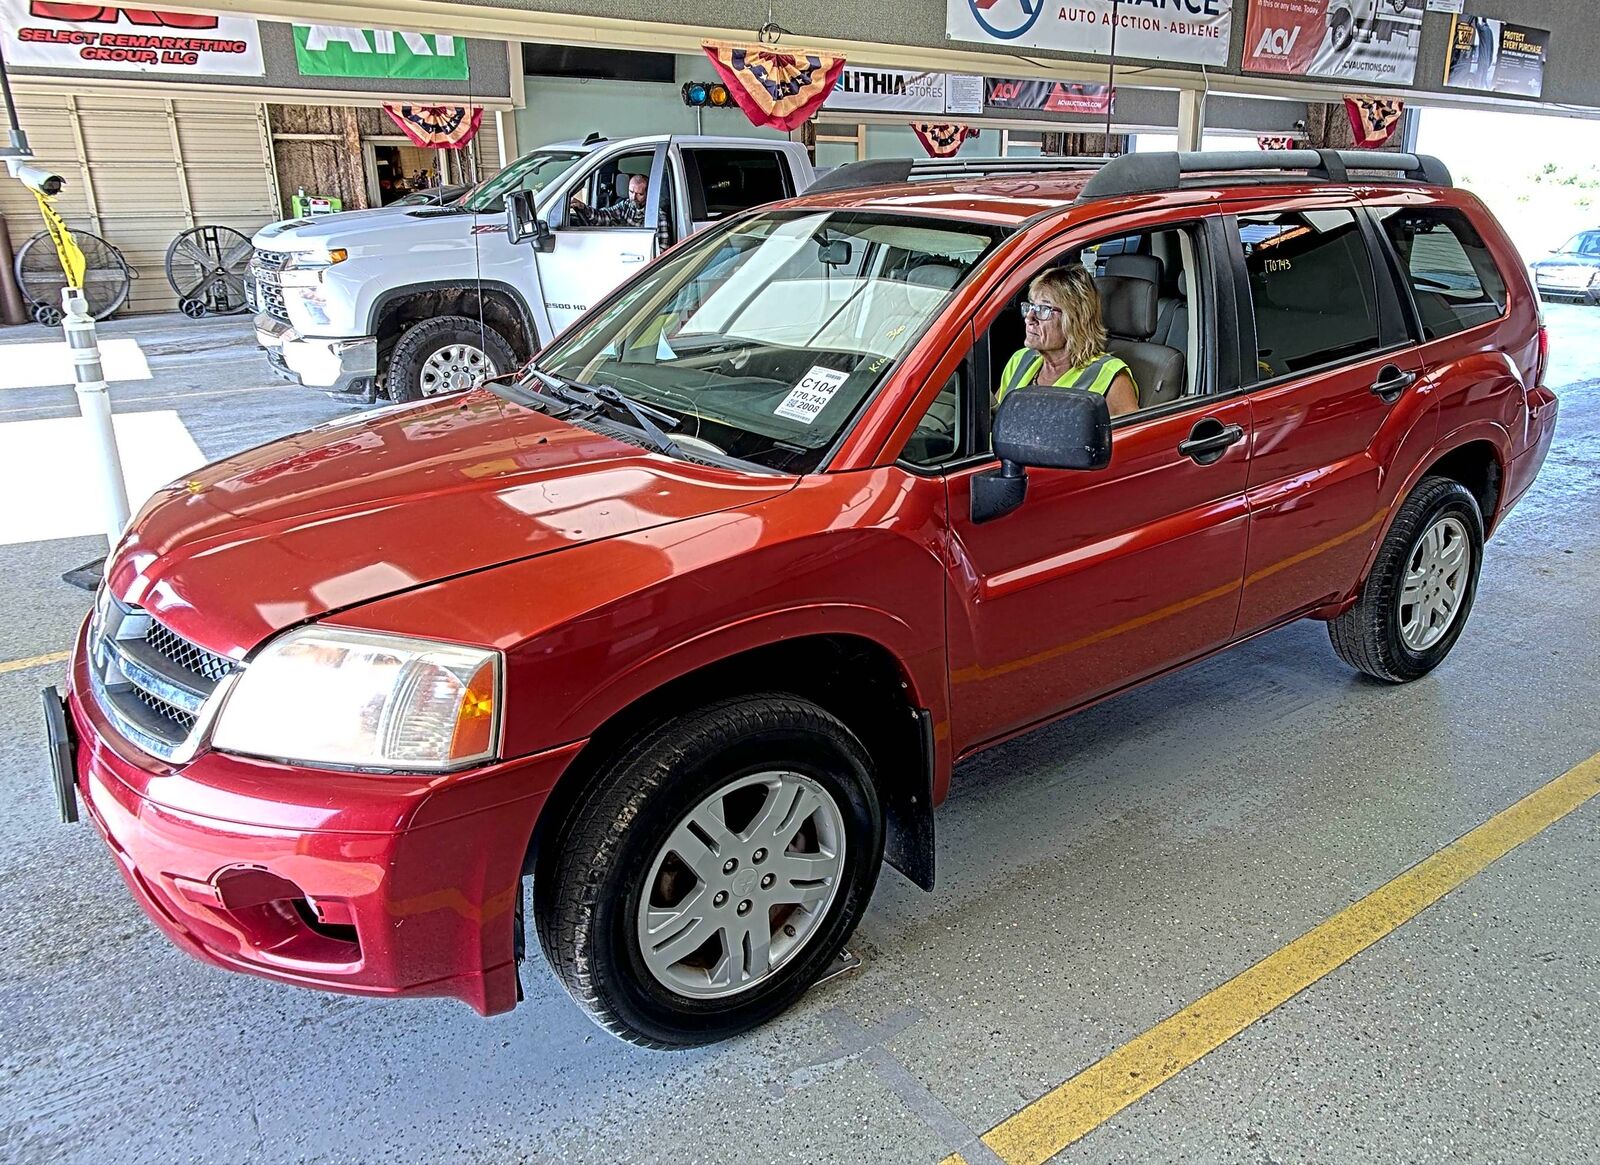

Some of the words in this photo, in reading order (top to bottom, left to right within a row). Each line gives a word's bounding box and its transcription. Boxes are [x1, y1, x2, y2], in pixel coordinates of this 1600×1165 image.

[1058, 7, 1096, 24] AUTO
[1102, 13, 1160, 31] AUCTION
[1170, 22, 1219, 38] ABILENE
[18, 27, 99, 44] SELECT
[100, 33, 247, 53] REMARKETING
[1252, 26, 1301, 57] ACV
[1503, 30, 1525, 42] PROTECT
[1503, 40, 1519, 50] EVERY
[80, 47, 158, 64] GROUP,
[161, 51, 198, 65] LLC
[1342, 60, 1396, 73] CVAUCTIONS.COM
[844, 70, 907, 95] LITHIA
[909, 75, 933, 87] AUTO
[909, 86, 943, 98] STORES
[991, 81, 1022, 100] ACV
[1264, 259, 1292, 274] 170743
[545, 302, 571, 310] 2500
[801, 378, 837, 395] C104
[797, 401, 820, 413] 2008
